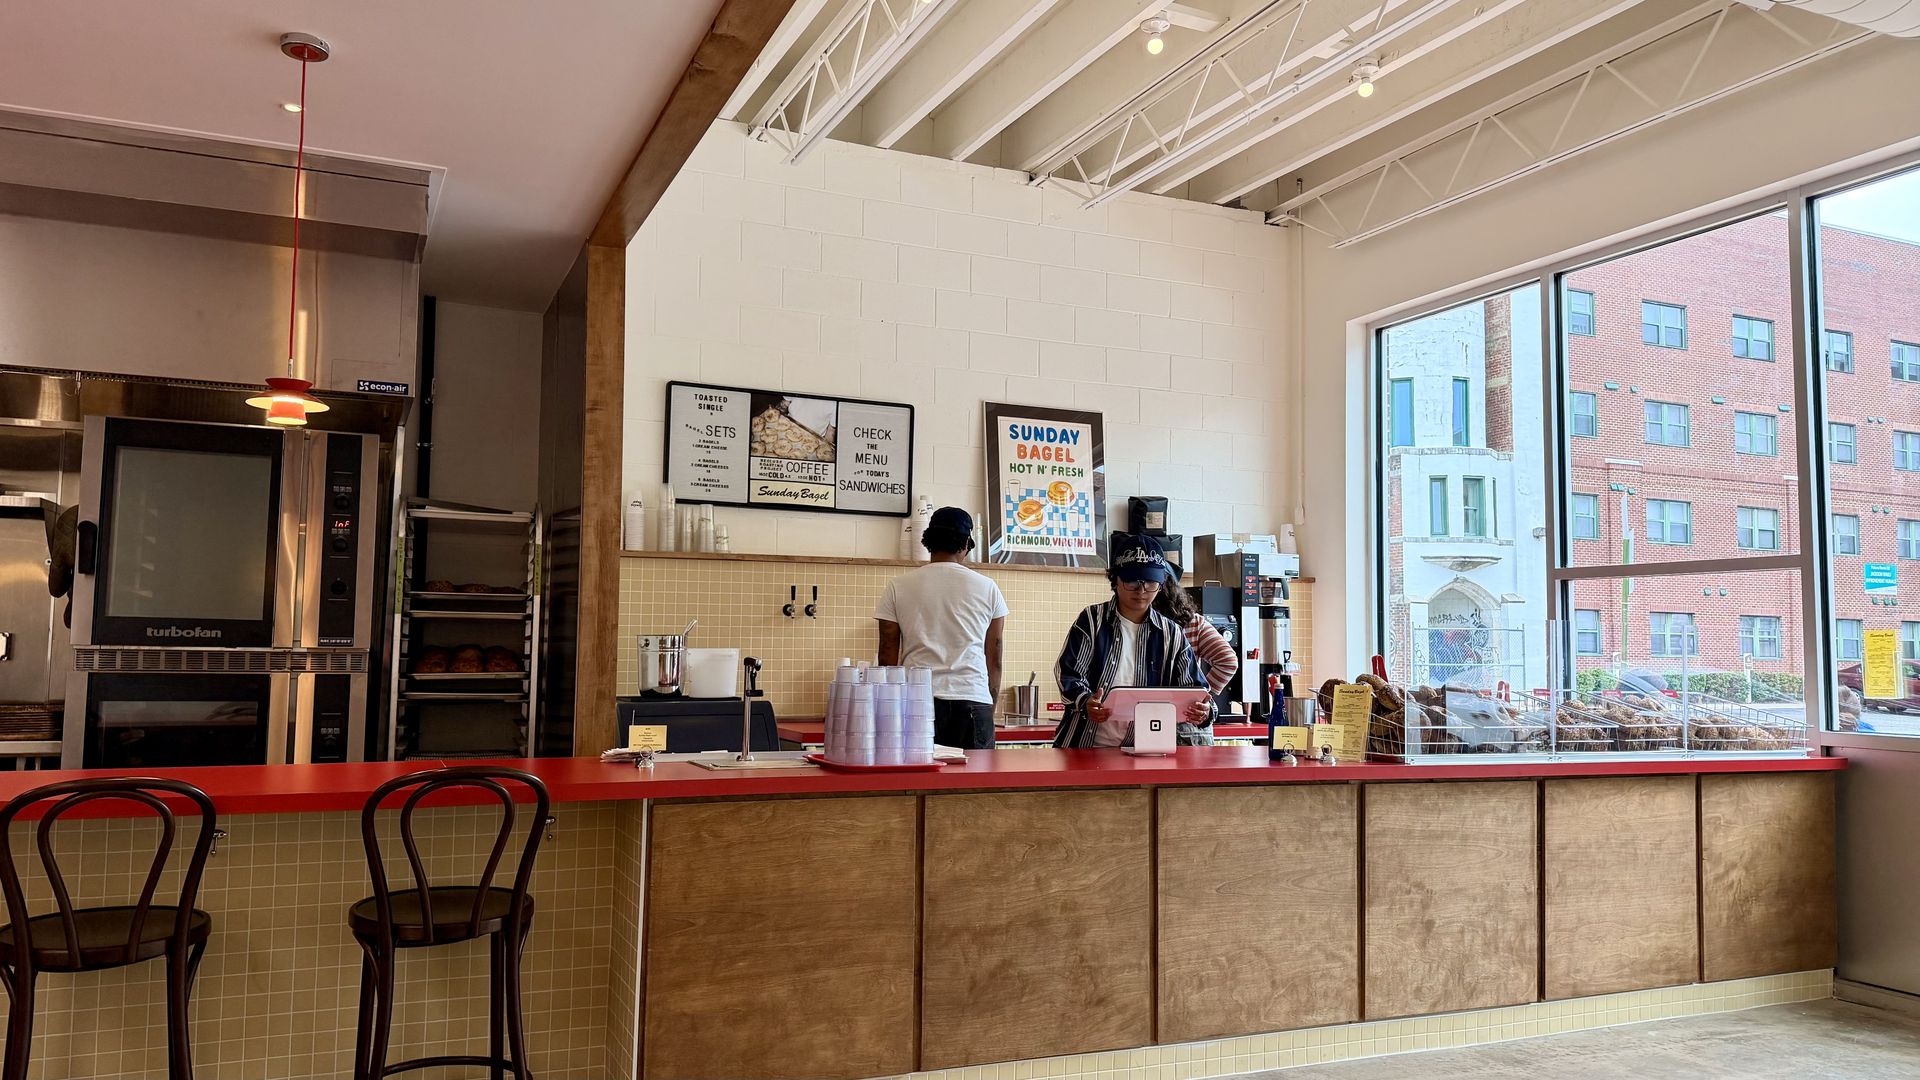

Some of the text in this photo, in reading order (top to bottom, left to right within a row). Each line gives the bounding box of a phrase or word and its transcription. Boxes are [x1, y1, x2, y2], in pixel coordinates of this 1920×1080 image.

[370, 383, 407, 392] econ-air
[694, 394, 728, 403] TOASTED
[698, 403, 723, 411] SINGLE
[705, 424, 736, 439] SETS
[853, 427, 892, 441] CHECK
[1009, 424, 1080, 445] SUNDAY
[867, 443, 878, 451] THE
[1017, 443, 1075, 463] BAGEL
[855, 452, 888, 466] MENU
[768, 471, 784, 479] COLD
[786, 461, 829, 476] COFFEE
[1009, 462, 1033, 475] HOT
[1051, 465, 1084, 478] FRESH
[758, 486, 829, 502] Sunday Bagel
[839, 479, 906, 495] SANDWICHES
[1007, 535, 1093, 547] RICHMOND, VIRGINIA
[1135, 546, 1149, 563] LA
[146, 625, 222, 639] turbofan
